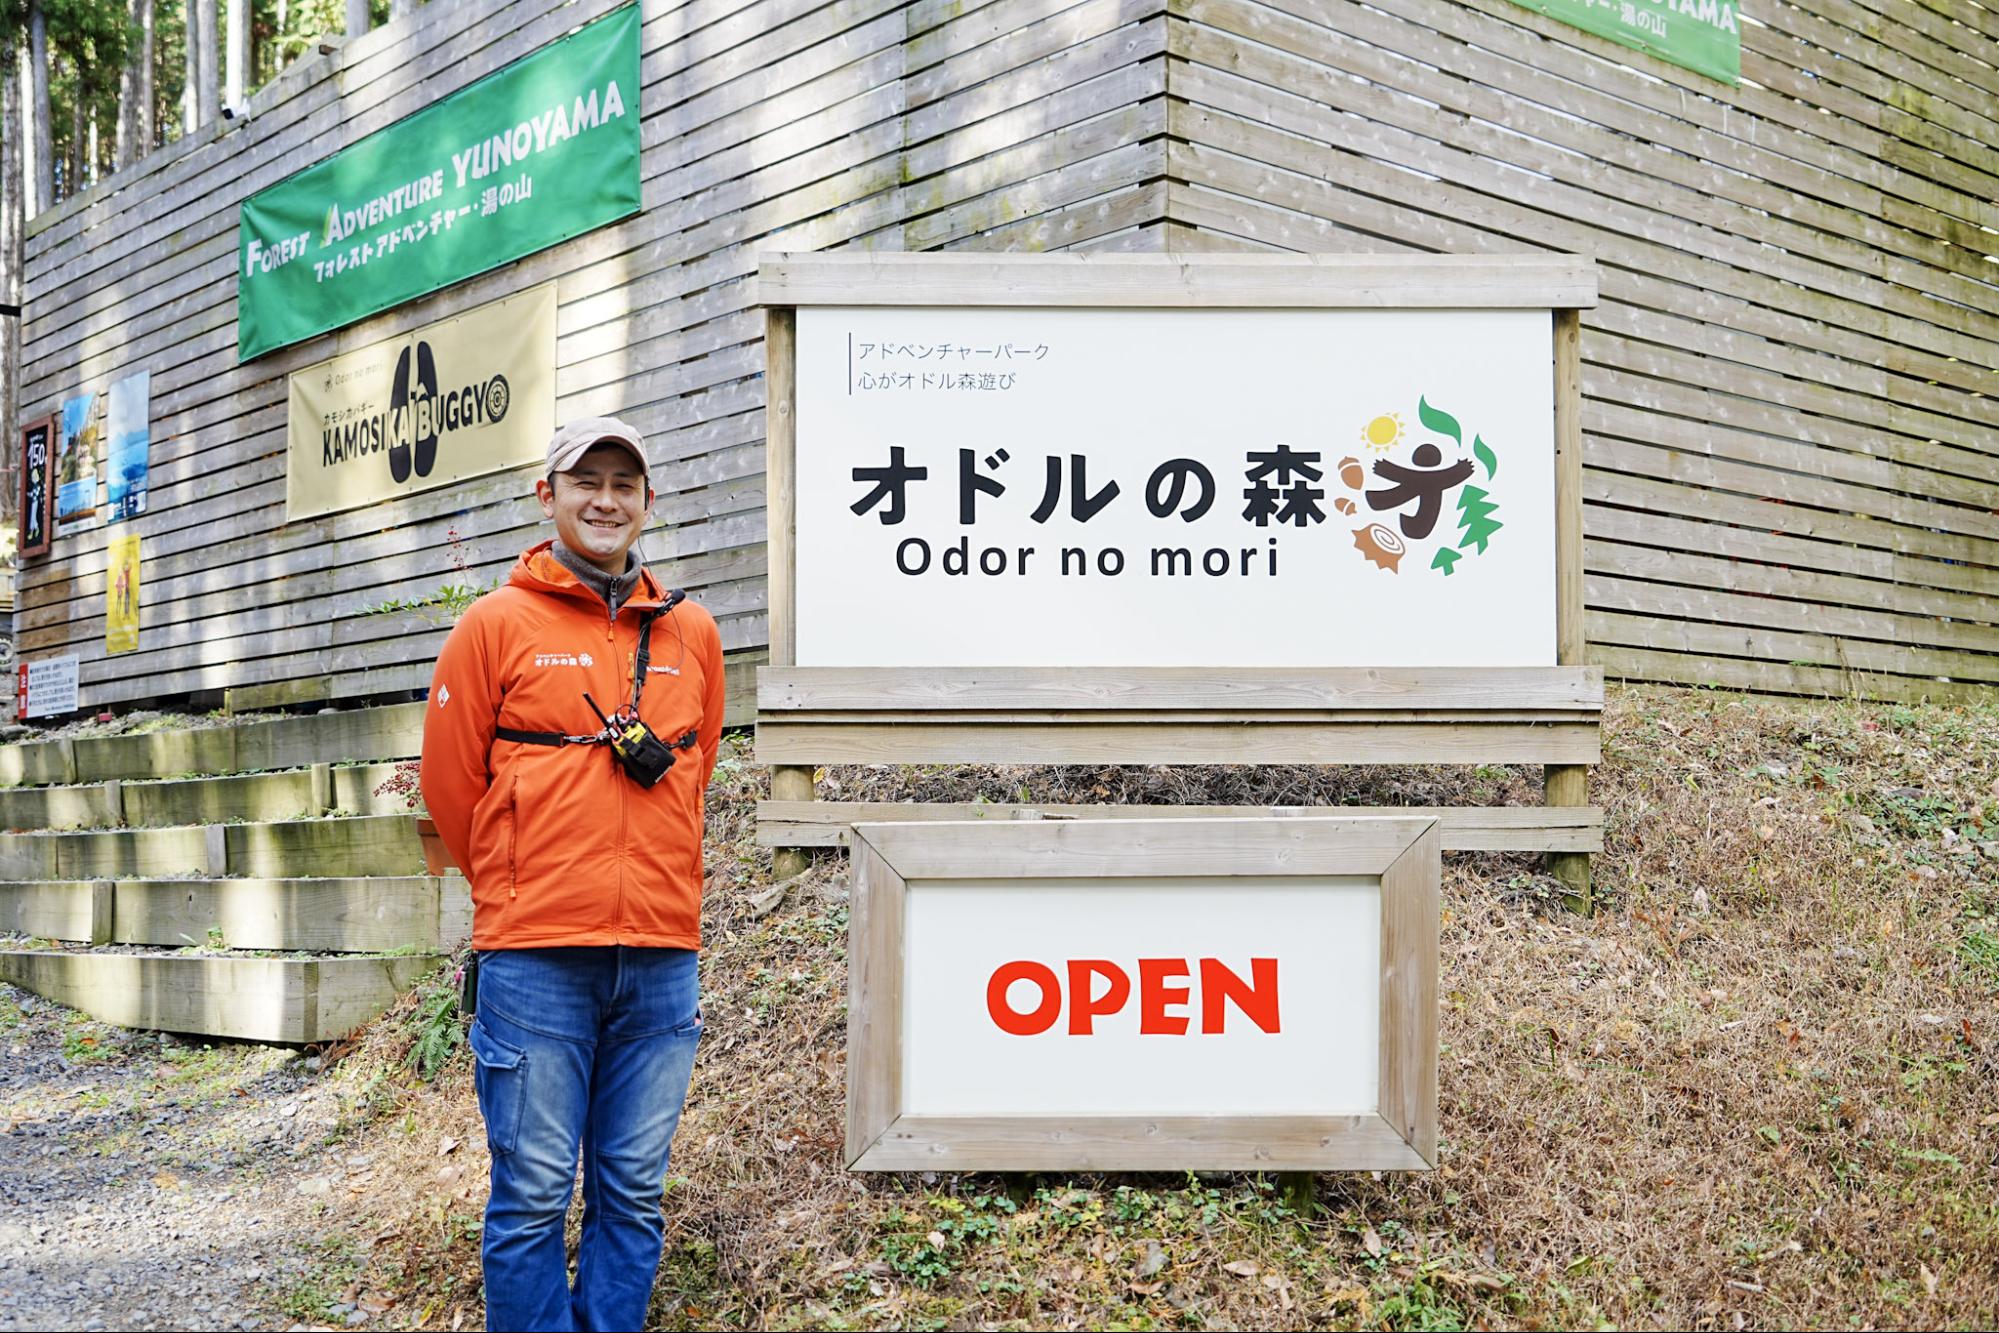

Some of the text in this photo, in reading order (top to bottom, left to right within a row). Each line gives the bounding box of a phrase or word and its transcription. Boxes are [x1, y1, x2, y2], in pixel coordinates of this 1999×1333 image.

[246, 81, 625, 277] FOREST ADVENTURE YUNOYAMA
[858, 371, 1017, 391] 心がオドル森遊び
[859, 343, 1049, 361] アドベンチャーパーク
[323, 407, 410, 467] KAMOSIKA
[850, 444, 1327, 528] オドルの森
[896, 535, 1277, 577] Odor no mori
[986, 957, 1281, 1037] OPEN
